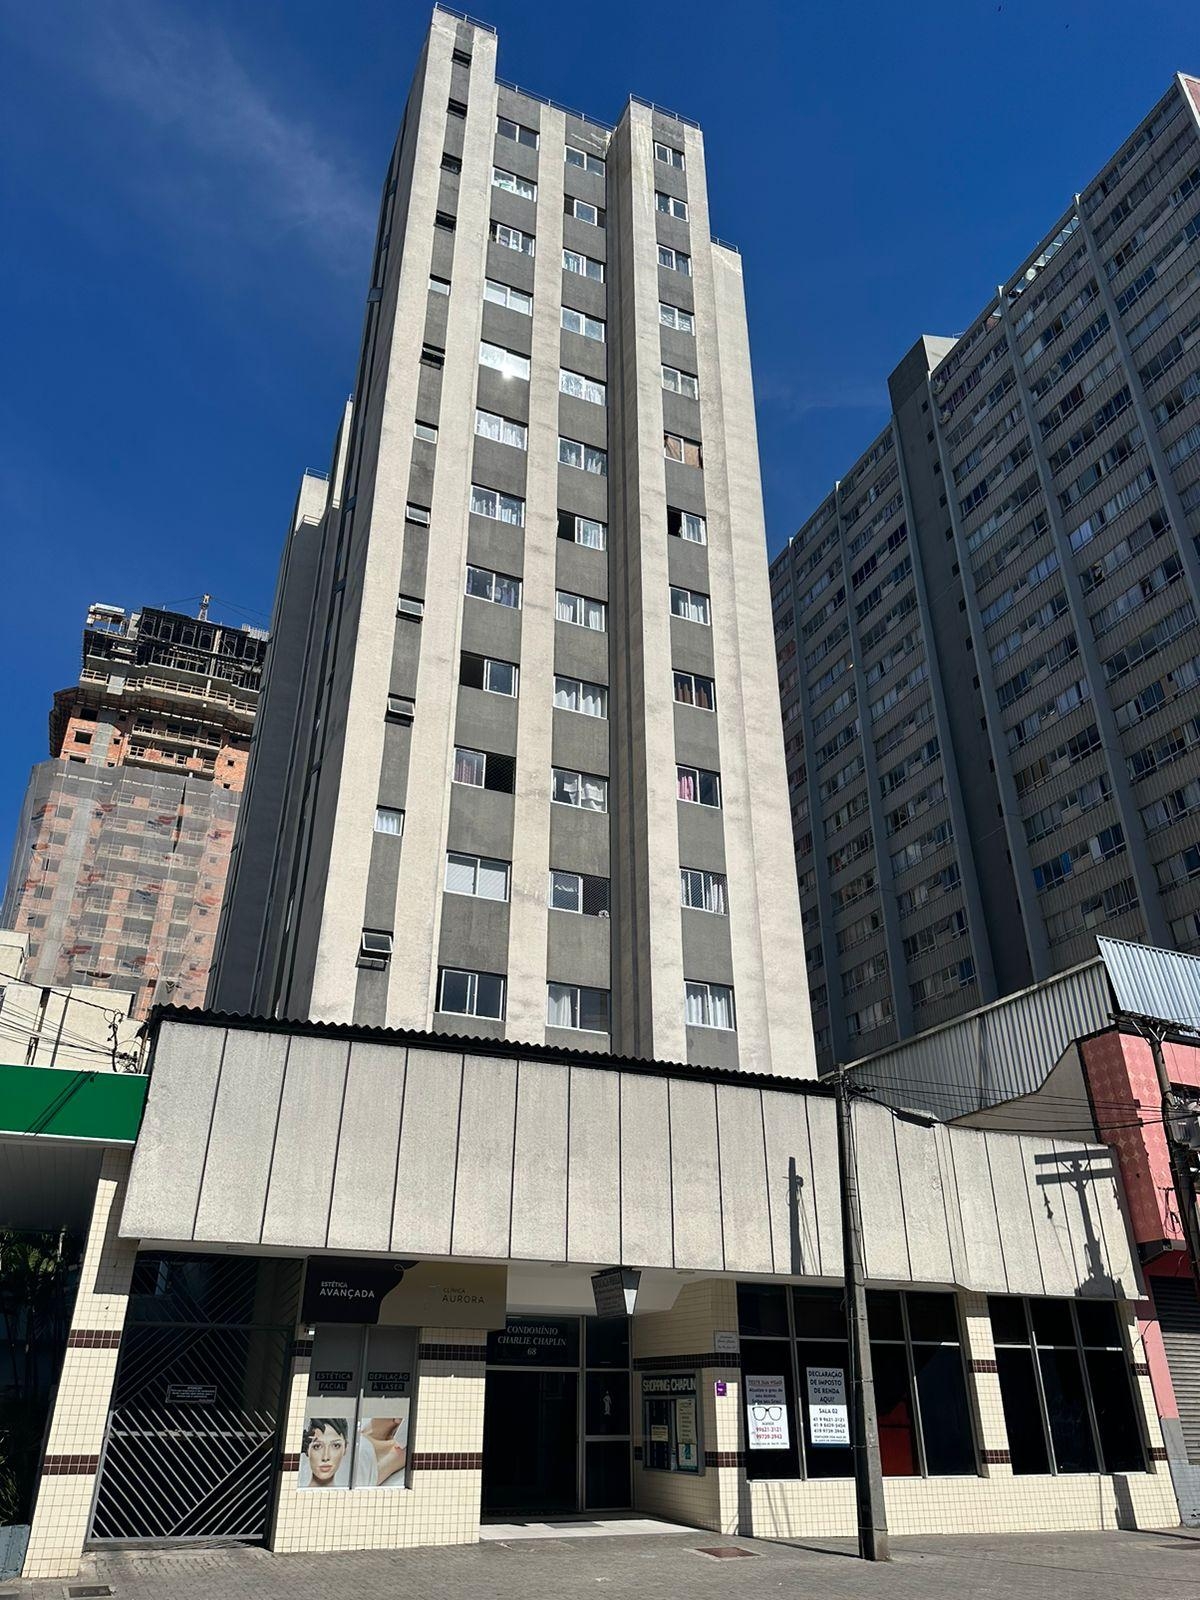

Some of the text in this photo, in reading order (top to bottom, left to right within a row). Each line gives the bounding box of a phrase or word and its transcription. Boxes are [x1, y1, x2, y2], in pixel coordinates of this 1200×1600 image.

[321, 1280, 348, 1288] ESTÉTICA
[319, 1288, 375, 1300] AVANÇADA
[442, 1295, 485, 1304] AURORA
[506, 1325, 559, 1336] CONDOMÍNIO
[497, 1335, 567, 1346] CHARLIE CHAPLIN
[527, 1346, 537, 1356] 68
[316, 1372, 351, 1380] ESTÉTICA
[369, 1372, 409, 1382] DEPILAÇÃO
[808, 1370, 843, 1379] DECLARAÇÃO
[320, 1382, 346, 1390] FACIAL
[642, 1379, 670, 1392] SHOPPING
